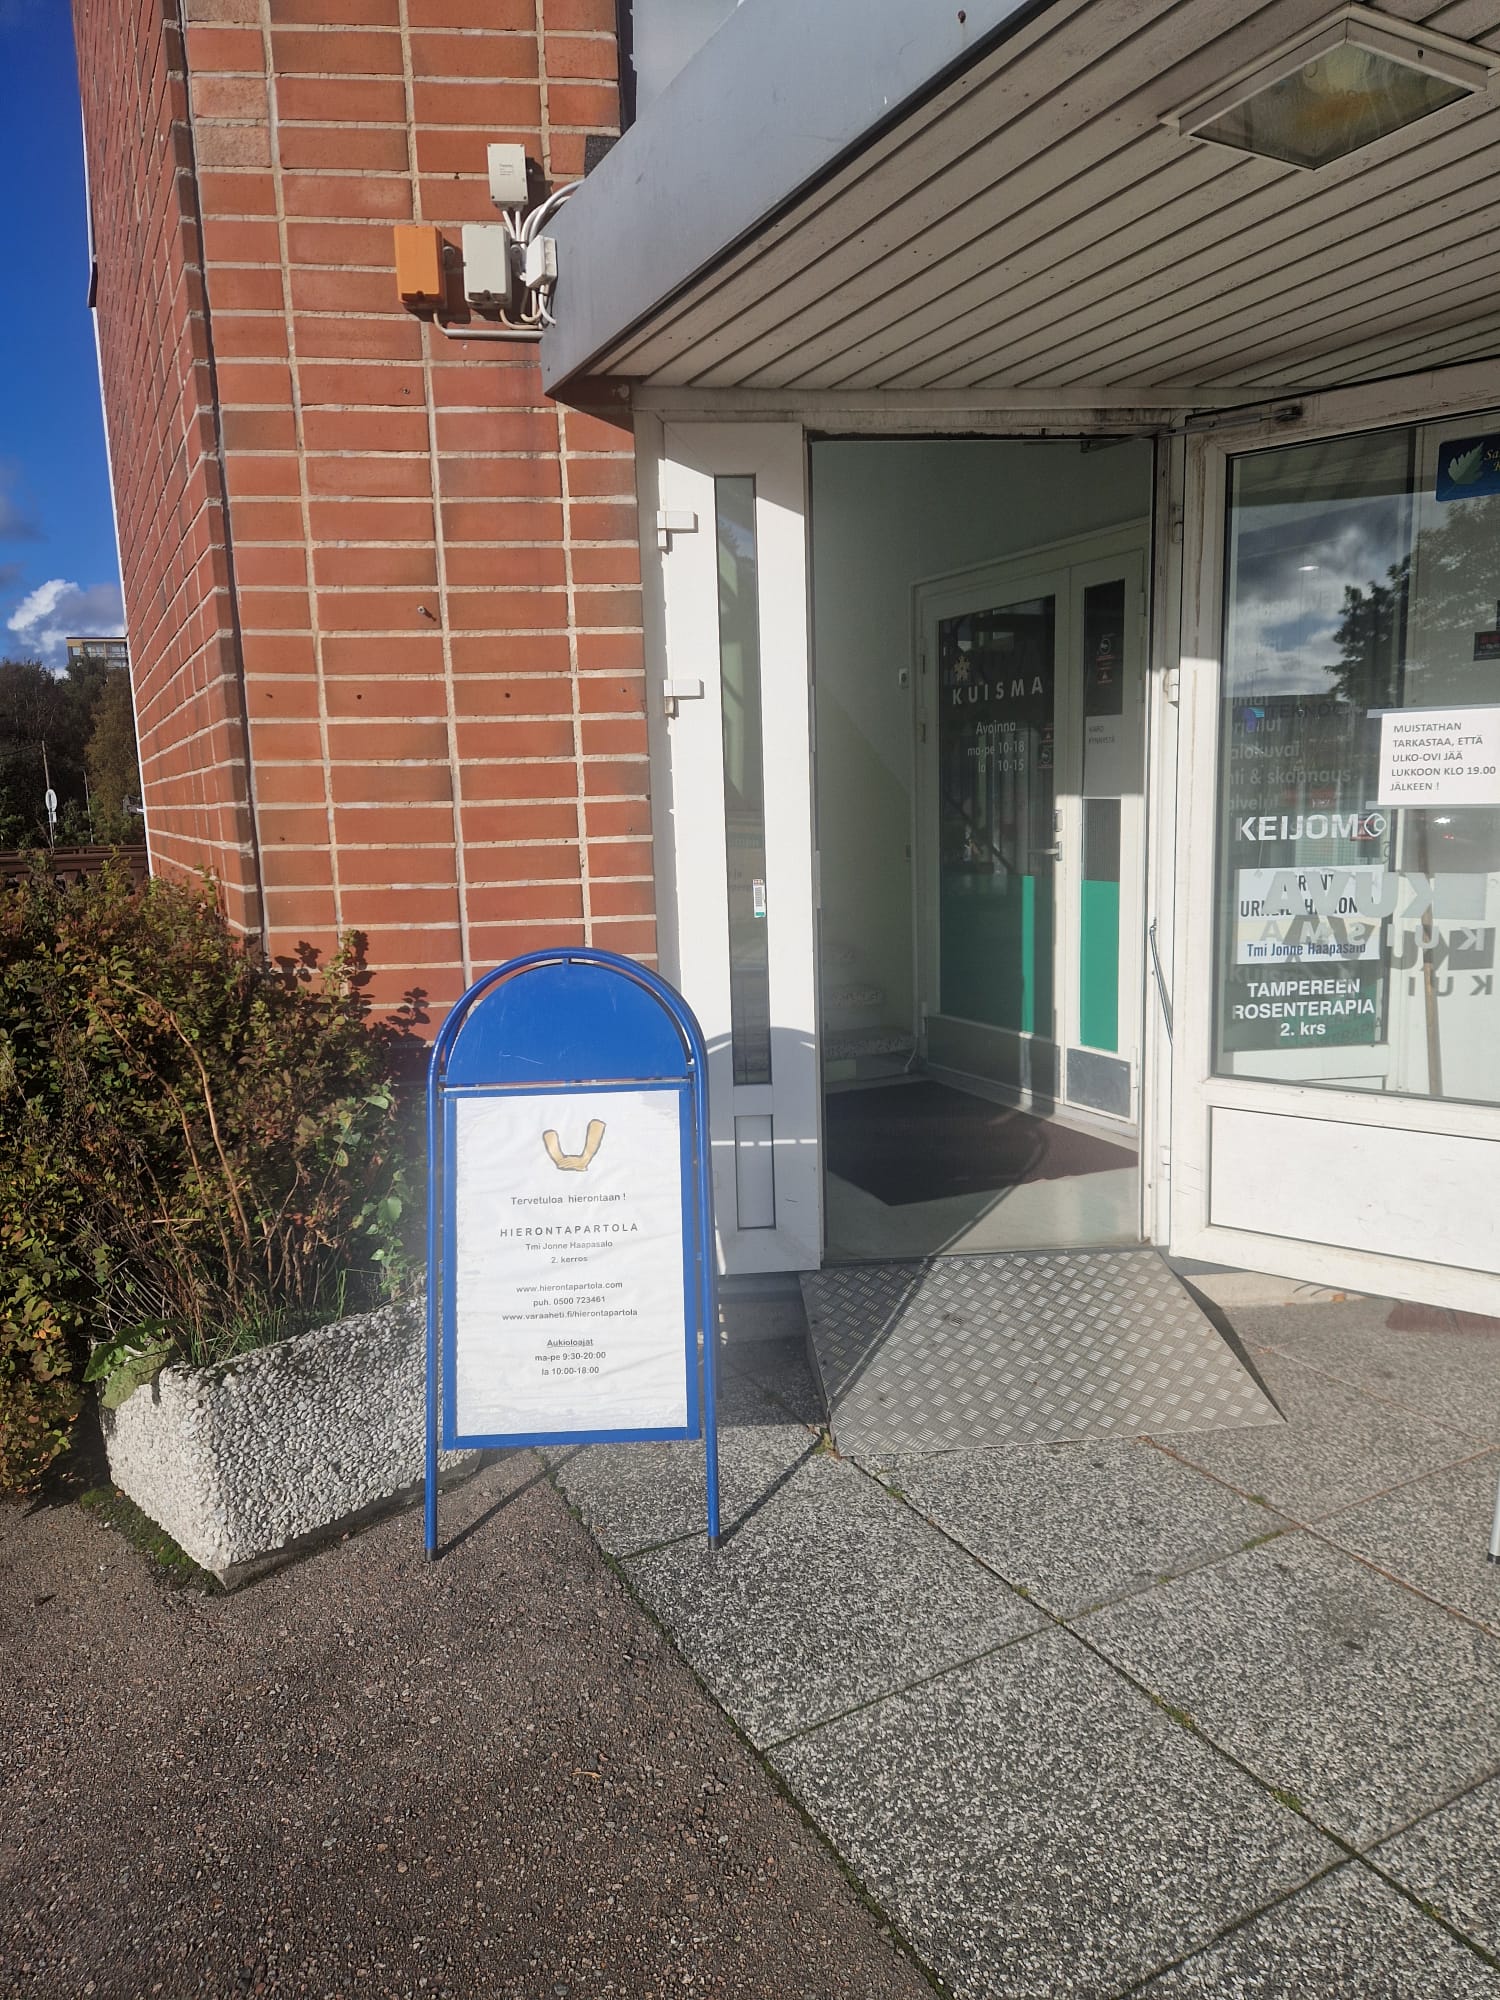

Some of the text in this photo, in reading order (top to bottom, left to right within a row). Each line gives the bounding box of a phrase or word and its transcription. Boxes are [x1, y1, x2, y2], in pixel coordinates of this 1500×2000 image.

[952, 676, 1044, 705] KUISMA
[1393, 722, 1462, 733] MUISTATHAN
[1393, 734, 1483, 747] TARKASTAA, ETTÄ
[998, 740, 1025, 754] 10-18
[1392, 751, 1463, 762] ULKO-OVI JÄÄ
[998, 759, 1024, 772] 10-15
[1391, 766, 1497, 777] LUKKOON KLO 19.00
[1390, 781, 1432, 791] JÄLKEEN
[1247, 943, 1267, 957] Tmi
[1271, 943, 1303, 957] Jonne
[1247, 978, 1361, 998] TAMPEREEN
[1232, 999, 1375, 1020] ROSENTERAPIA
[1280, 1022, 1295, 1037] 2.
[1300, 1021, 1326, 1036] krs
[511, 1195, 563, 1205] Tervetuloa
[568, 1193, 620, 1204] hierontaan
[500, 1223, 638, 1237] HIERONTAPARTOLA
[525, 1242, 541, 1251] Tmi
[570, 1240, 613, 1250] Haapasalo
[551, 1255, 588, 1264] 2. kerros
[516, 1281, 623, 1293] www.hierontapartola.com
[533, 1297, 551, 1307] puh.
[553, 1297, 574, 1306] 0500
[502, 1308, 638, 1320] www.varaaheti.fi/hierontapartola
[547, 1338, 594, 1348] Aukioloajat
[535, 1353, 560, 1362] ma-pe
[541, 1368, 549, 1376] la
